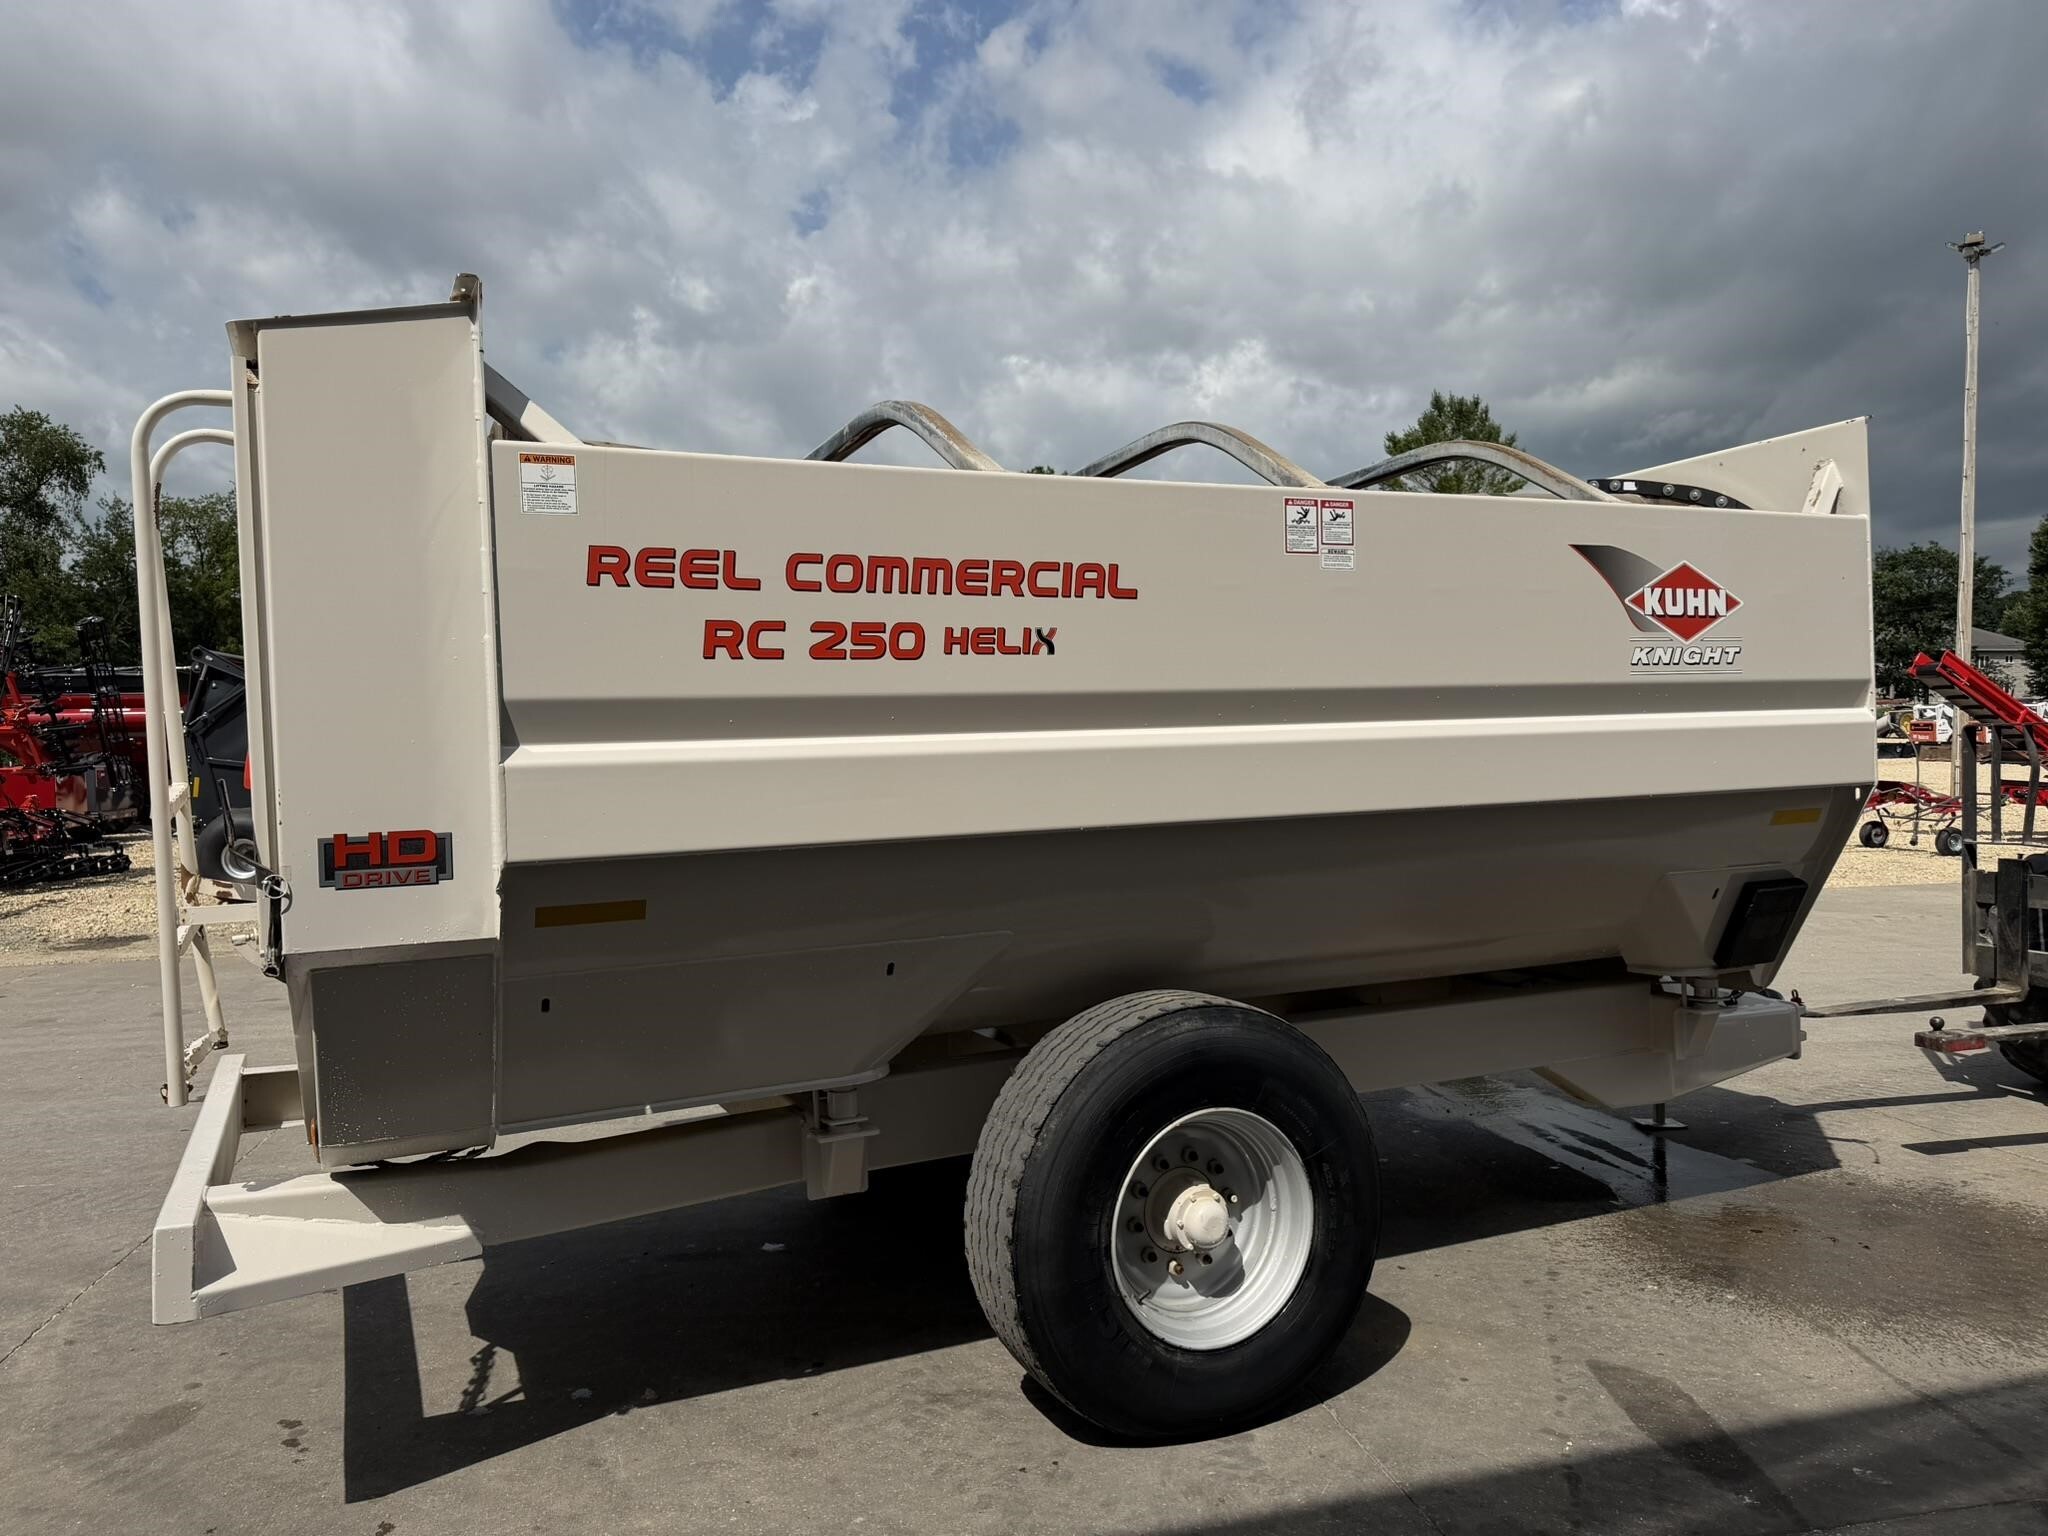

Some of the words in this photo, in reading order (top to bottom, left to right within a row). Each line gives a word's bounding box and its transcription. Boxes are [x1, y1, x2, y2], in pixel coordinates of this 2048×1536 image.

[533, 456, 571, 464] WARNING
[587, 545, 761, 591] REEL
[785, 552, 1138, 600] COMMERCIAL
[1643, 587, 1727, 618] KUHN
[703, 619, 786, 660] RC
[809, 621, 925, 661] 250
[943, 626, 1058, 656] HELIX
[1630, 645, 1741, 666] KNIGHT
[333, 830, 437, 868] HD
[342, 870, 431, 887] DRIVE
